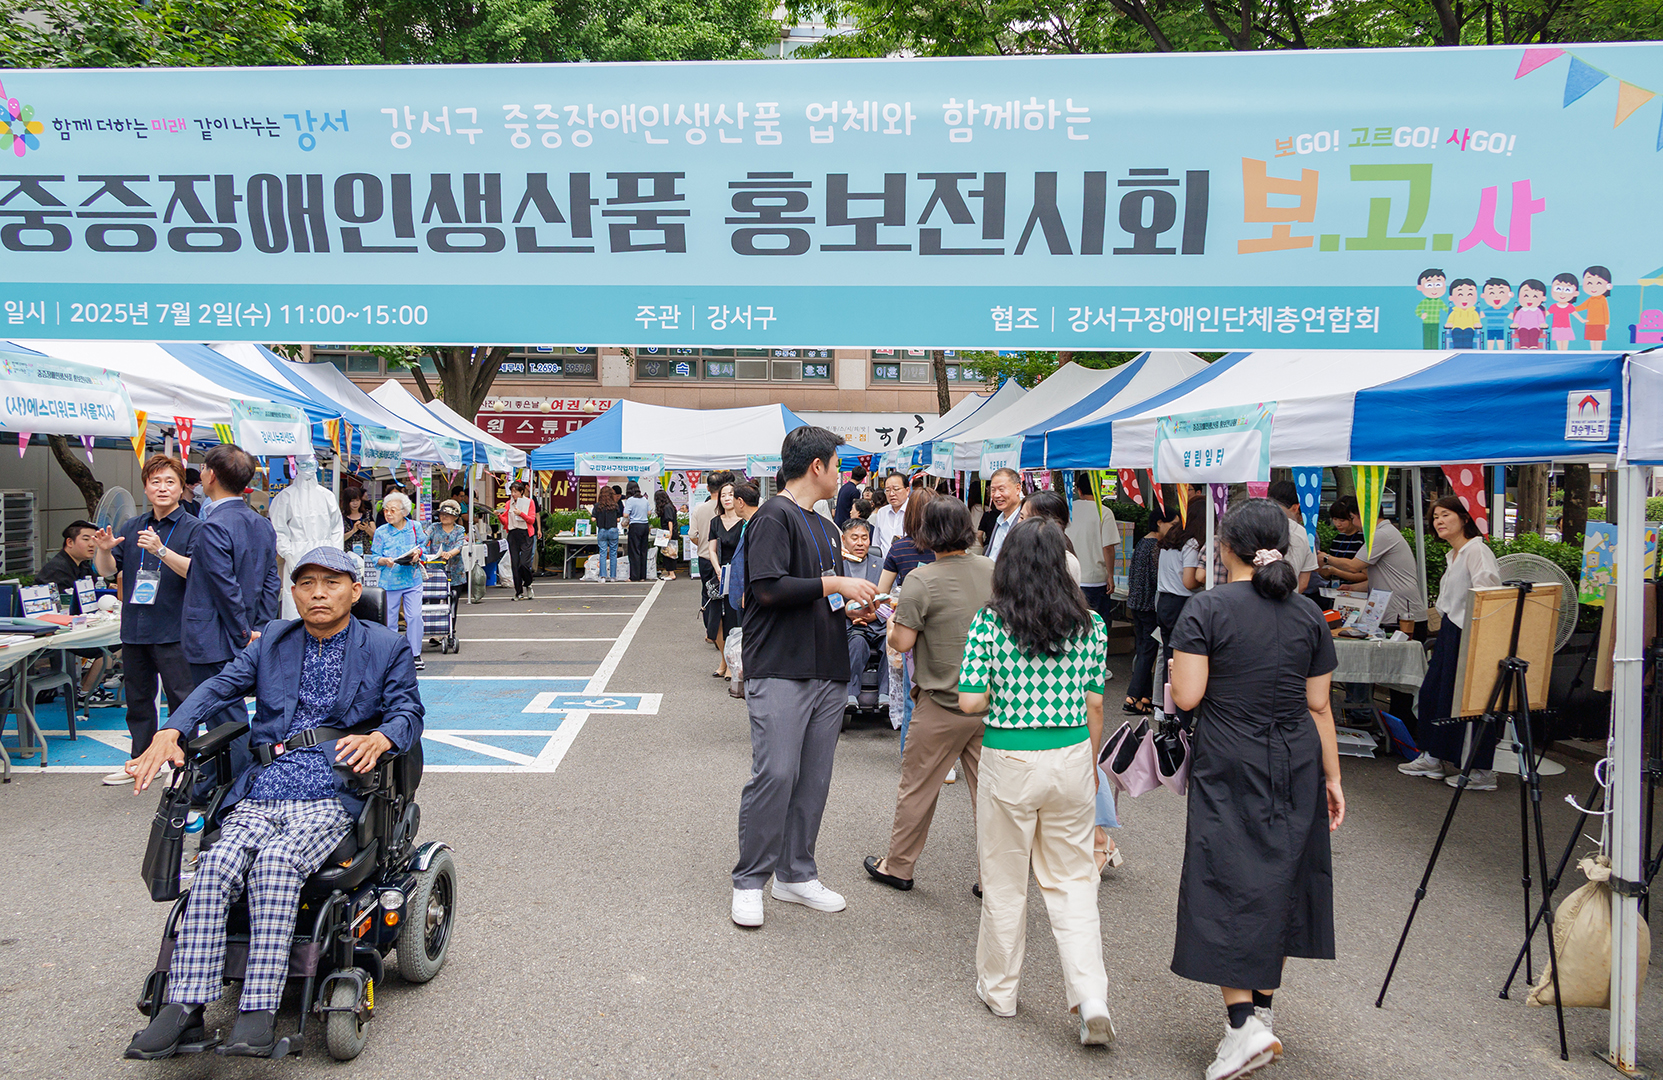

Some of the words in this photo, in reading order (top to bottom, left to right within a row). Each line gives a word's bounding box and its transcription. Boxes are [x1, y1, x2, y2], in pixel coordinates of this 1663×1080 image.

[52, 117, 93, 141] 함께
[96, 117, 149, 139] 더하는
[151, 117, 187, 133] 미래
[193, 117, 229, 141] 같이
[232, 117, 281, 138] 나누는
[283, 109, 350, 152] 강서
[380, 105, 484, 149] 강서구
[502, 101, 783, 149] 중증장애인생산품
[805, 99, 917, 145] 업체와
[941, 96, 1092, 143] 함께하는
[1274, 129, 1340, 158] 보GO!
[1348, 126, 1440, 149] 고르GO!
[1446, 127, 1517, 156] 사GO!
[0, 172, 691, 254] 중증장애인생산품
[724, 168, 1211, 256] 홍보전시회
[4, 300, 46, 325] 일시
[70, 301, 149, 326] 2025년
[155, 301, 191, 326] 7월
[198, 302, 271, 328] 2일(수)
[280, 304, 428, 326] 11:00~15:00
[634, 304, 682, 330] 주관
[707, 304, 777, 331] 강서구
[990, 305, 1040, 332] 협조
[1067, 305, 1380, 334] 강서구장애인단체총연합회
[5, 395, 79, 419] (사)에스디워크
[80, 401, 116, 421] 서울지사
[551, 399, 580, 411] 여권
